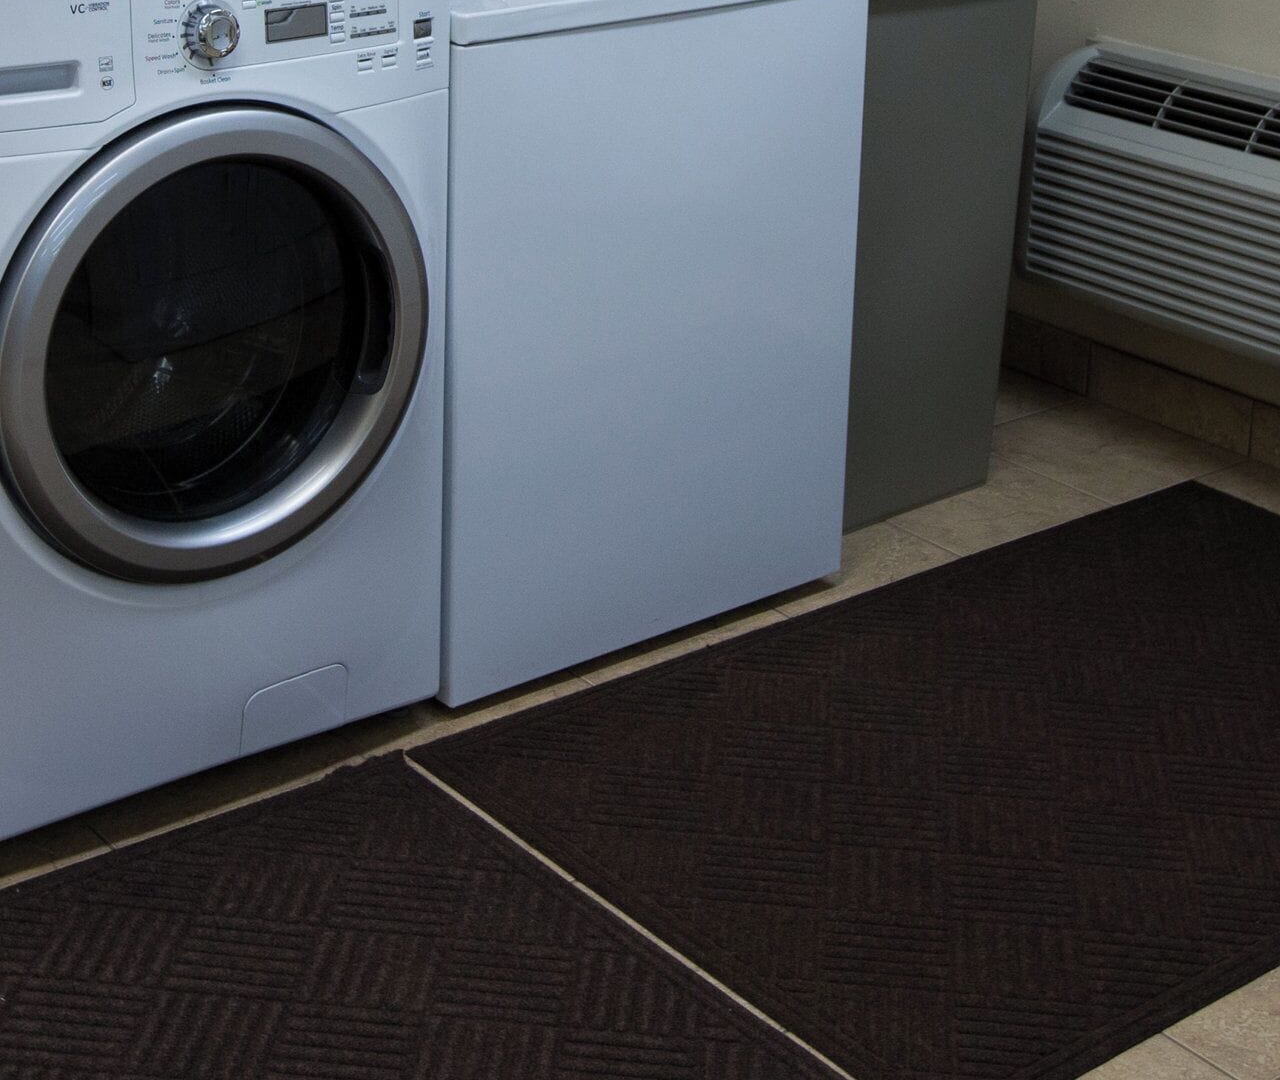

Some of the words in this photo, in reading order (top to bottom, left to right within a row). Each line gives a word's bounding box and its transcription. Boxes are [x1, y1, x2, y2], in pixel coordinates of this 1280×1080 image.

[70, 4, 86, 14] VC
[330, 24, 344, 32] Temp
[200, 77, 217, 85] Basket
